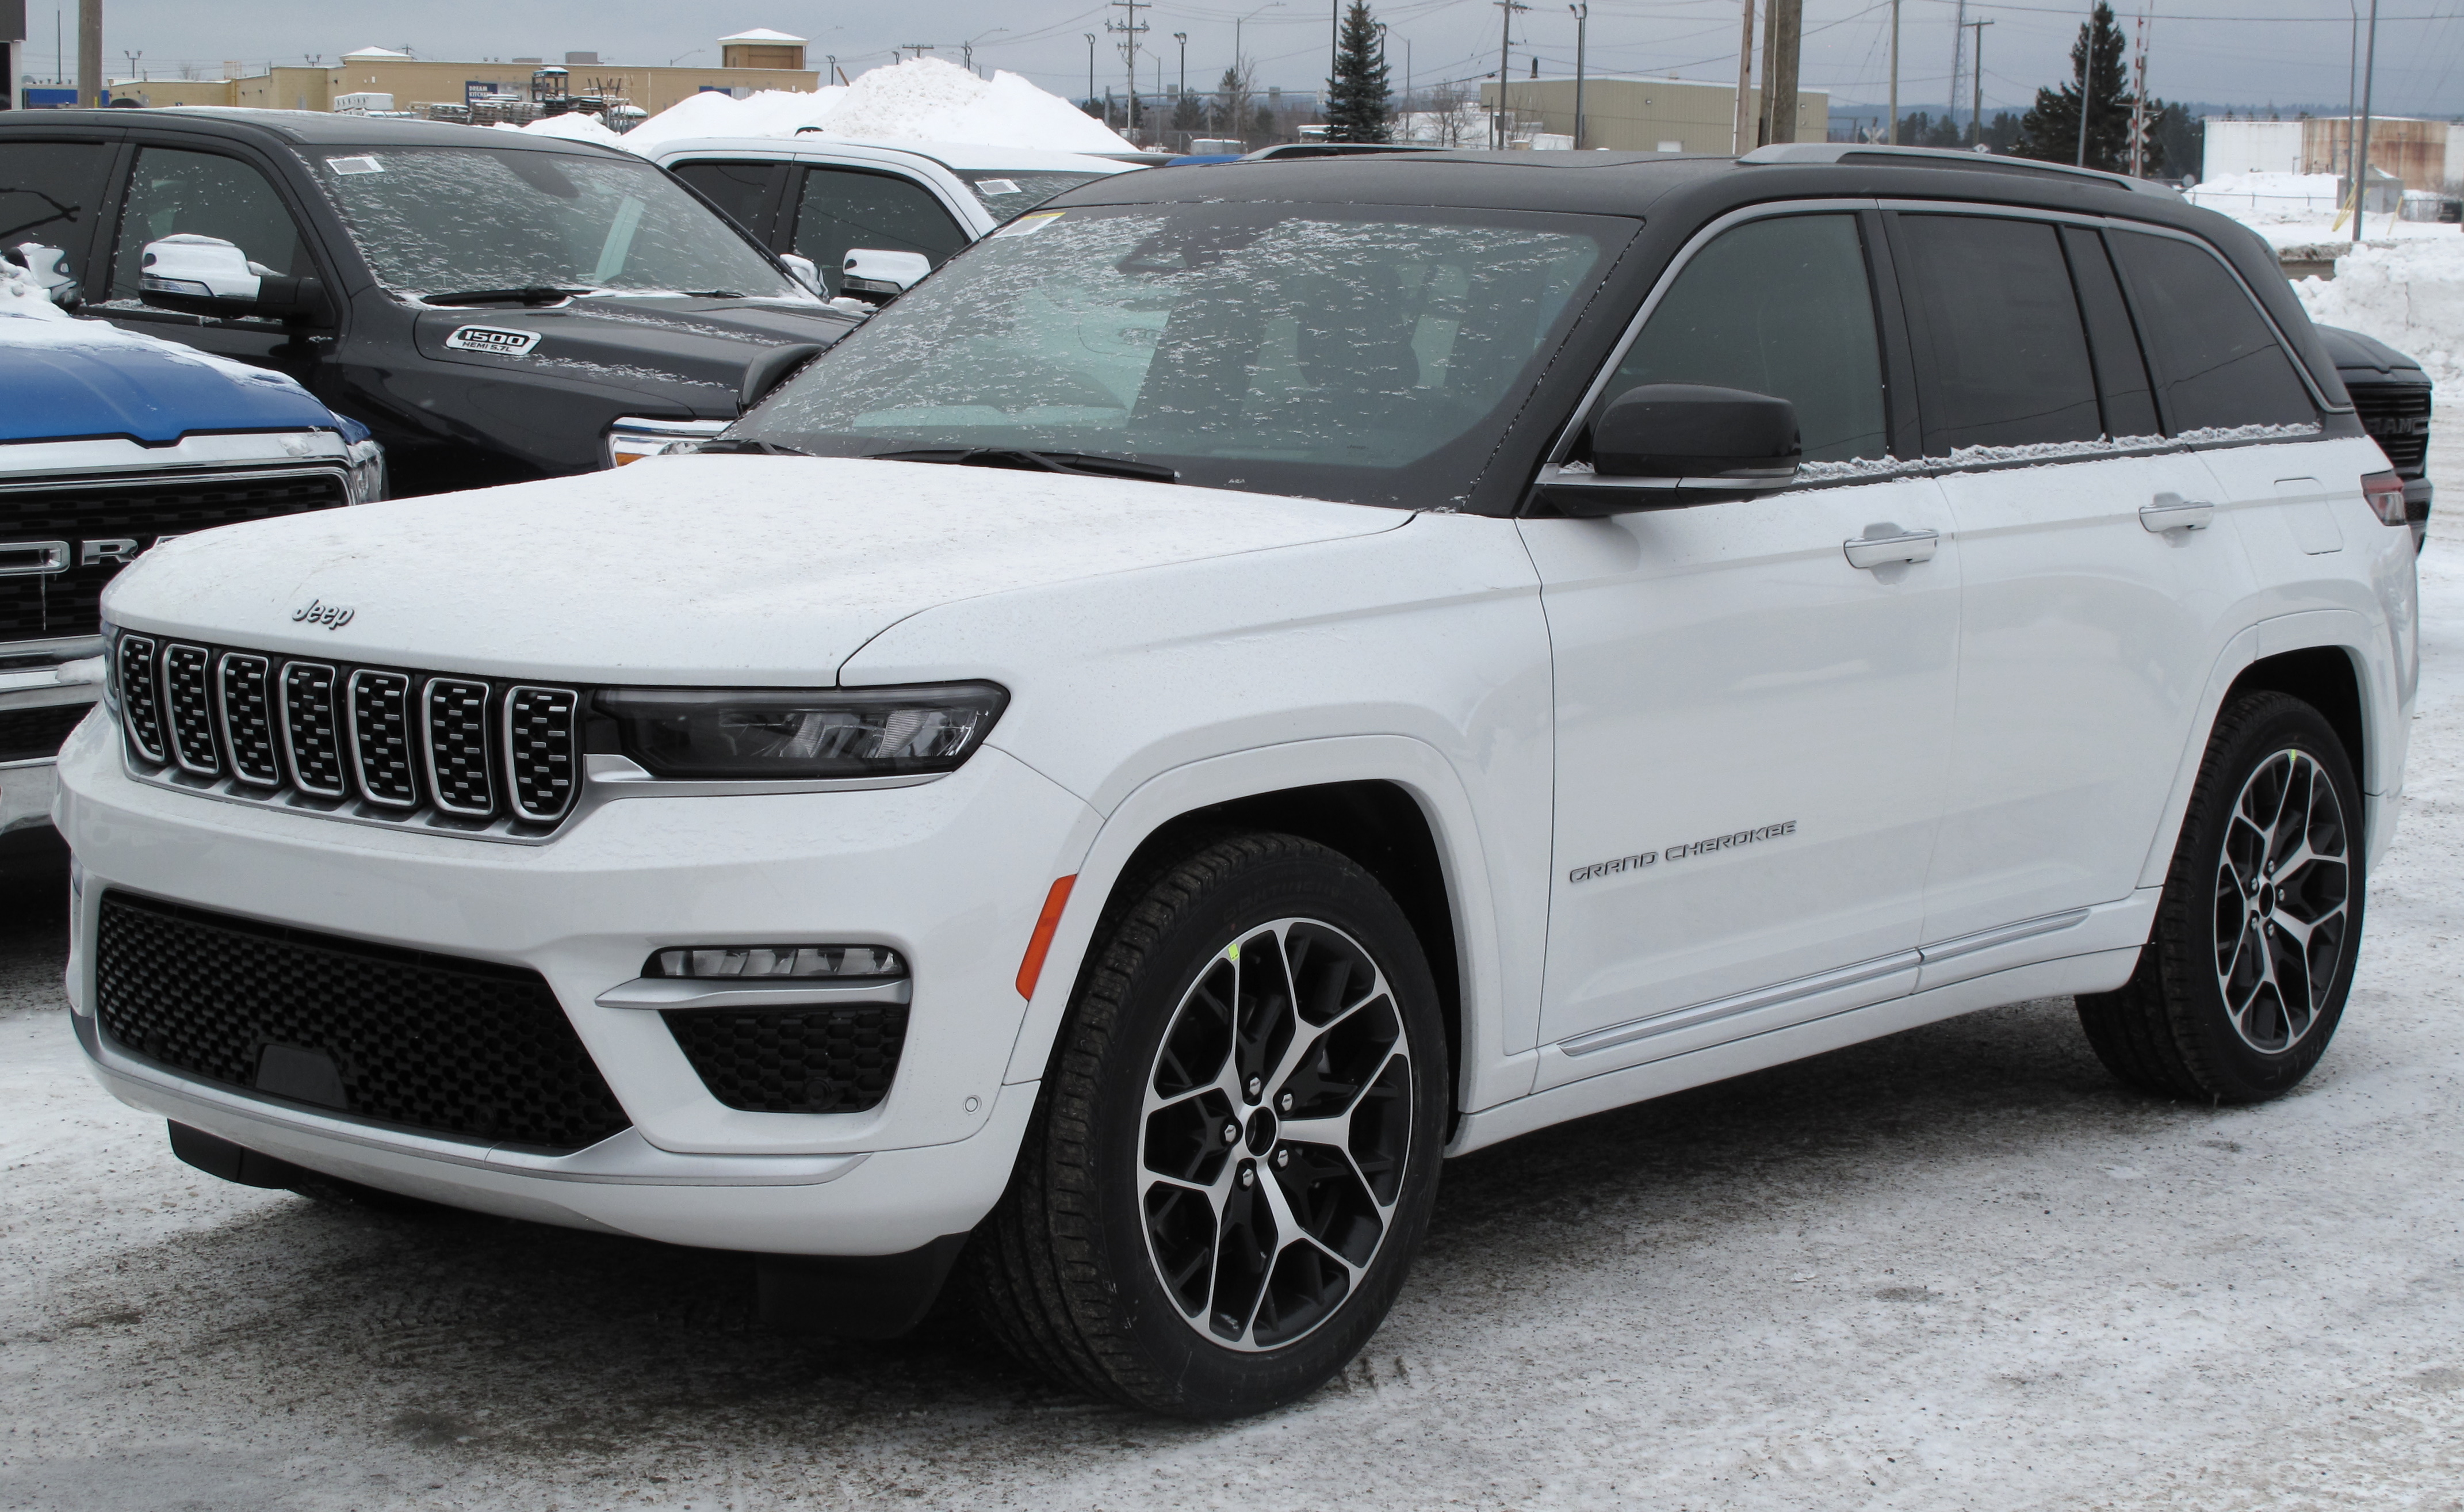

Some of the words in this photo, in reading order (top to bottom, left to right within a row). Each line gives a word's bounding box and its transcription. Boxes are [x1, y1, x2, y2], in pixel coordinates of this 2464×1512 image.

[462, 341, 488, 349] HEMI
[465, 330, 525, 346] 1500
[2364, 417, 2412, 434] RAM
[292, 599, 354, 630] Jeep
[1569, 851, 1659, 884] GRAND
[1665, 820, 1797, 861] CHEROKEE
